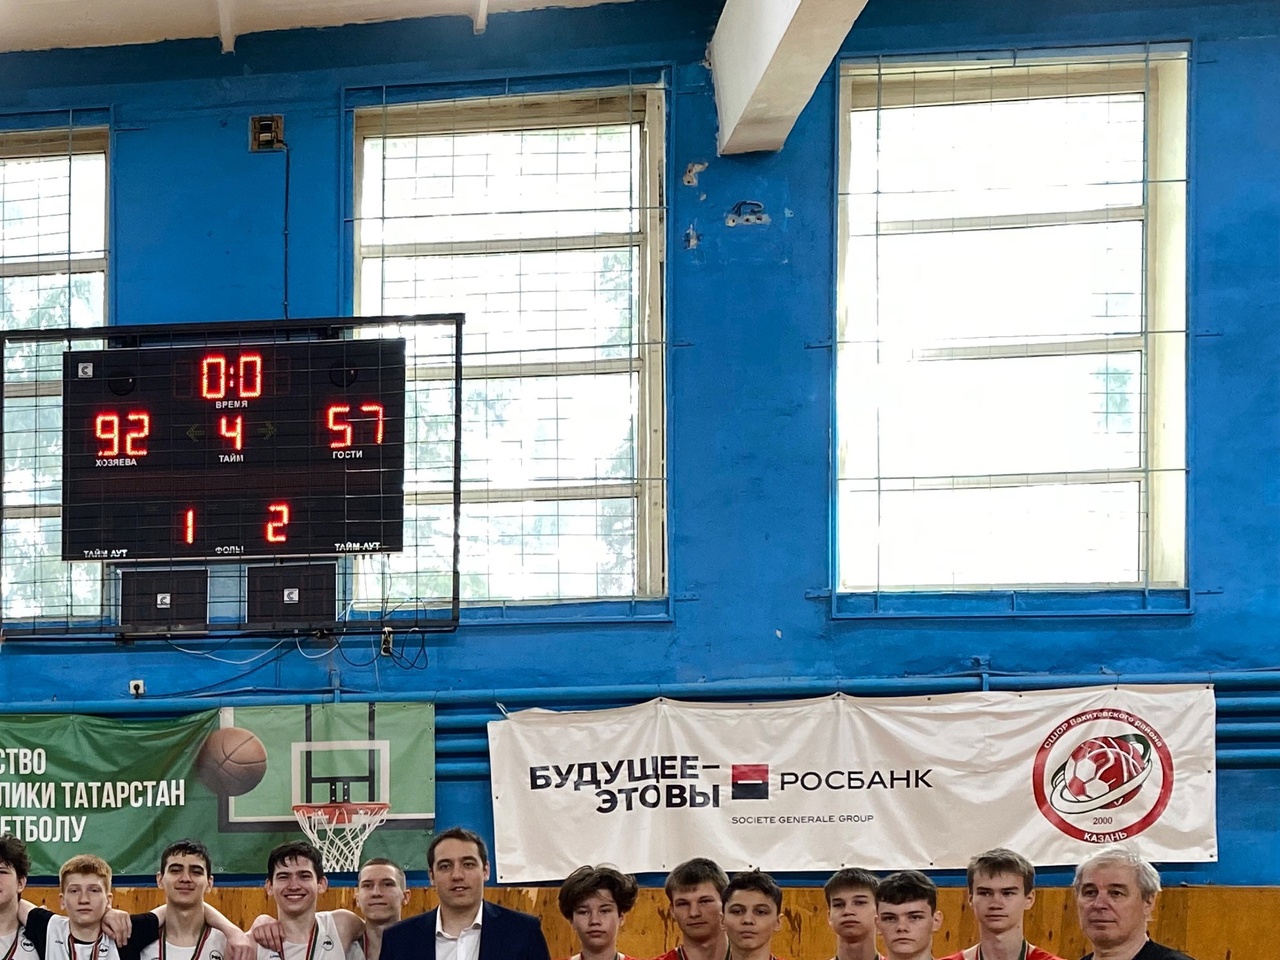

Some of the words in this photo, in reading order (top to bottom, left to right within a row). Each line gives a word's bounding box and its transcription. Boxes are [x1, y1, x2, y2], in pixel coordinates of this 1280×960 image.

[201, 354, 262, 399] 0:0
[215, 400, 248, 409] ВРЕМЯ
[95, 413, 150, 456] 92
[220, 416, 242, 450] 4
[327, 404, 384, 449] 57
[95, 457, 138, 467] ХОЗЯЕВА
[218, 453, 244, 463] ТАЙМ
[332, 450, 363, 460] ГОСТИ
[186, 508, 195, 545] 1
[266, 503, 289, 542] 2
[1044, 722, 1069, 749] СШОР
[1070, 711, 1134, 726] Вахитовского
[1134, 720, 1163, 748] района
[781, 769, 933, 791] РОСБАНК
[61, 779, 185, 808] ТАТАРСТАН
[731, 816, 776, 824] SOCIETE
[779, 816, 835, 825] GENERALE
[839, 815, 874, 824] GROUP
[1093, 817, 1113, 825] 2000
[1084, 831, 1127, 843] КАЗАНЬ
